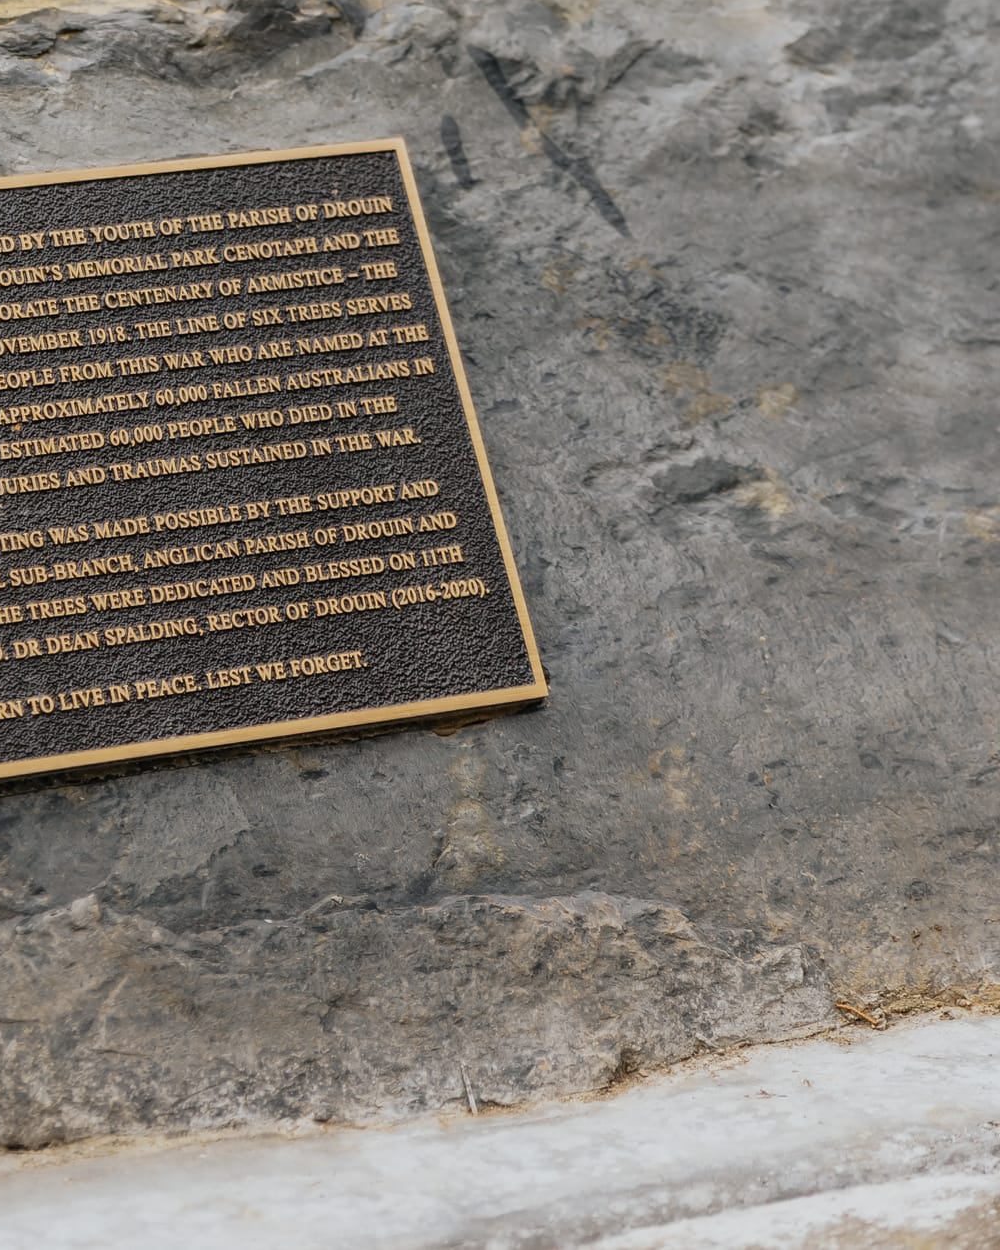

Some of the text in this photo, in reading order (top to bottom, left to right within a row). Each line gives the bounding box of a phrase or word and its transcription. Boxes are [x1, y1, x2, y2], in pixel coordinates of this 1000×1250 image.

[18, 230, 45, 250] BY
[50, 227, 87, 246] THE
[88, 221, 155, 242] YOUTH
[159, 217, 183, 235] OF
[185, 212, 224, 232] THE
[227, 206, 292, 228] PARISH
[295, 204, 318, 221] OF
[322, 196, 392, 218] DROUIN
[66, 253, 168, 279] MEMORIAL
[170, 246, 220, 267] PARK
[223, 237, 318, 261] CENOTAPH
[323, 232, 361, 251] AND
[361, 227, 400, 246] THE
[62, 294, 100, 313] THE
[104, 281, 213, 308] CENTENARY
[218, 276, 241, 295] OF
[248, 267, 344, 293] ARMISTICE
[360, 260, 397, 279] THE
[88, 324, 132, 344] 1918.
[134, 320, 173, 339] THE
[176, 314, 220, 334] LINE
[223, 311, 247, 329] OF
[252, 307, 283, 326] SIX
[285, 301, 342, 321] TREES
[346, 292, 412, 315] SERVES
[58, 360, 114, 382] FROM
[116, 355, 160, 375] THIS
[162, 350, 206, 369] WAR
[208, 345, 252, 364] WHO
[258, 339, 293, 359] ARE
[296, 332, 364, 354] NAMED
[368, 329, 388, 346] AT
[391, 323, 429, 343] THE
[155, 384, 208, 405] 60,000
[211, 375, 280, 398] FALLEN
[287, 359, 410, 390] AUSTRALIANS
[413, 356, 434, 374] IN
[110, 423, 164, 446] 60,000
[166, 415, 236, 438] PEOPLE
[239, 409, 283, 429] WHO
[287, 402, 332, 424] DIED
[336, 399, 357, 417] IN
[359, 395, 397, 414] THE
[66, 466, 105, 486] AND
[108, 453, 203, 480] TRAUMAS
[204, 440, 306, 468] SUSTAINED
[312, 438, 331, 455] IN
[335, 432, 372, 452] THE
[375, 427, 421, 446] WAR.
[47, 523, 89, 544] WAS
[92, 515, 150, 539] MADE
[152, 504, 242, 531] POSSIBLE
[245, 501, 271, 519] BY
[274, 495, 312, 515] THE
[316, 483, 395, 509] SUPPORT
[400, 479, 439, 499] AND
[9, 554, 140, 585] SUB-BRANCH,
[143, 540, 239, 568] ANGLICAN
[243, 530, 310, 554] PARISH
[314, 526, 336, 545] OF
[341, 517, 413, 541] DROUIN
[417, 511, 457, 531] AND
[26, 595, 88, 619] TREES
[89, 587, 146, 610] WERE
[149, 573, 255, 603] DEDICATED
[261, 567, 299, 588] AND
[303, 555, 385, 582] BLESSED
[389, 551, 417, 570] ON
[421, 544, 464, 566] 11TH
[12, 638, 43, 658] DR
[45, 629, 100, 654] DEAN
[104, 616, 206, 645] SPALDING,
[206, 605, 283, 631] RECTOR
[286, 602, 308, 620] OF
[314, 591, 386, 616] DROUIN
[391, 577, 489, 609] (2016-2020).
[26, 694, 55, 714] TO
[58, 687, 106, 710] LIVE
[108, 682, 131, 703] IN
[133, 674, 201, 699] PEACE.
[205, 665, 251, 688] LEST
[255, 660, 287, 681] WE
[289, 649, 368, 677] FORGET.
